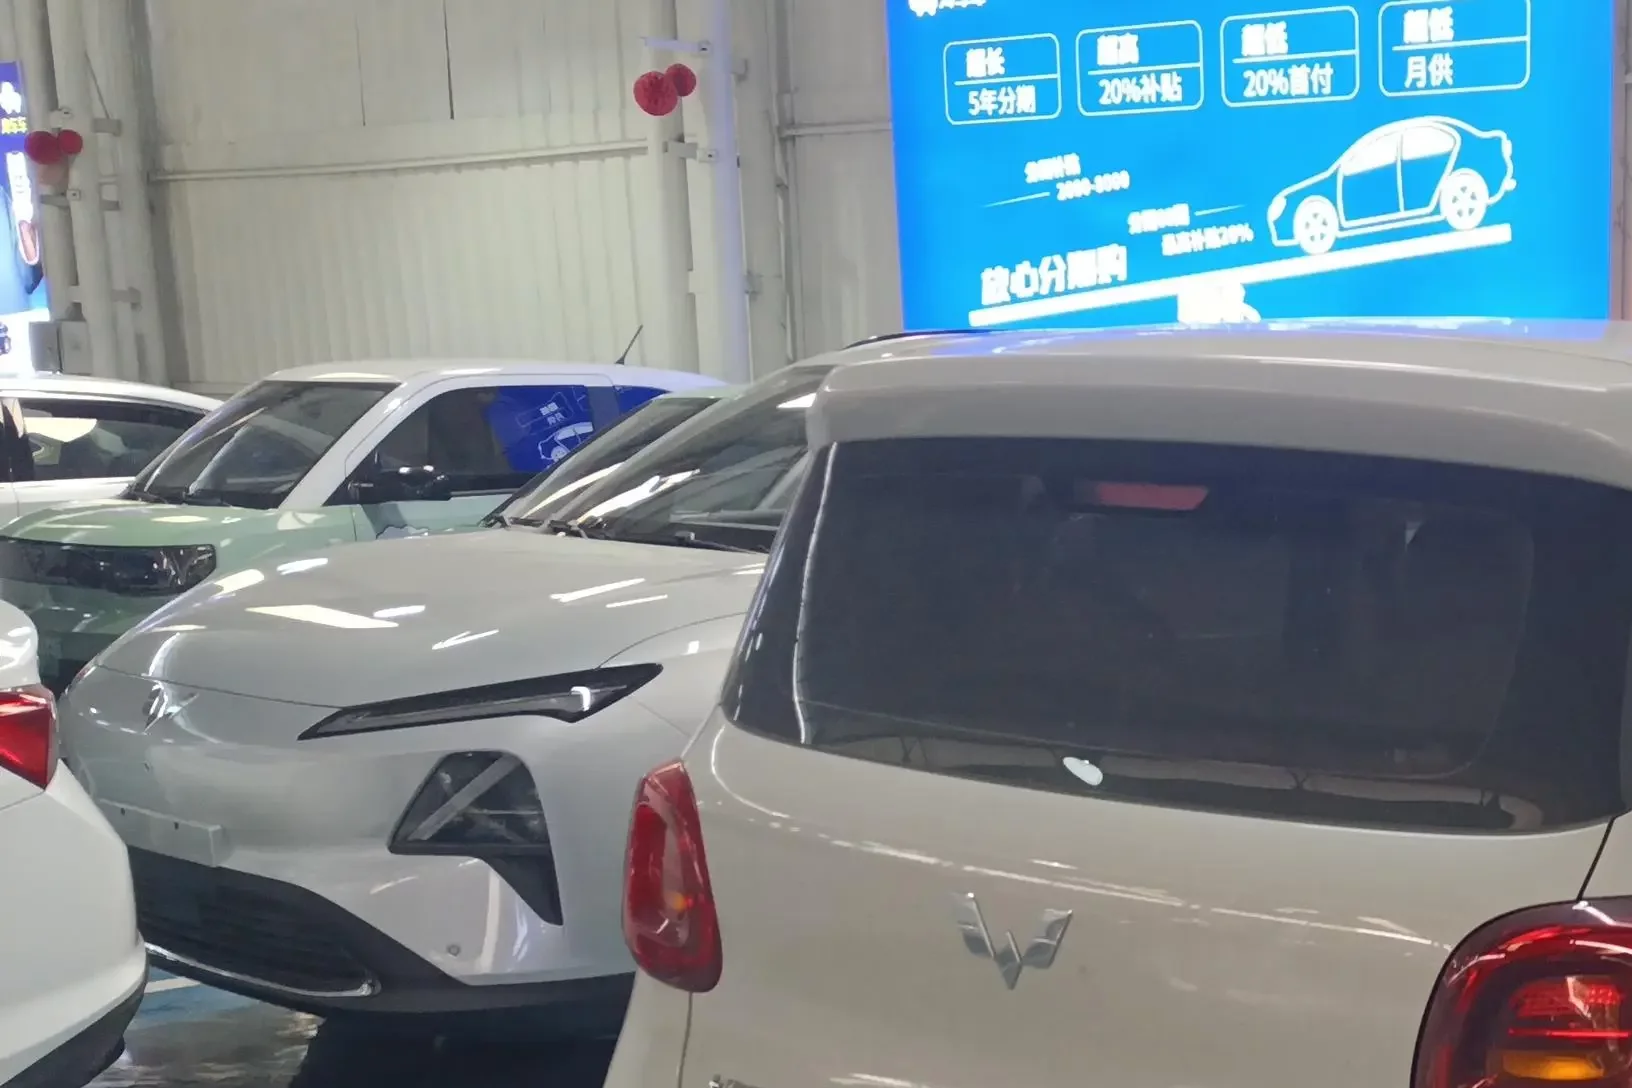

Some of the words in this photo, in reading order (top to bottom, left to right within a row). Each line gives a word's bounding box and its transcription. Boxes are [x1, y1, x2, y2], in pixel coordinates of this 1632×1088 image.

[1243, 62, 1334, 98] 20%首付
[1404, 53, 1454, 88] 月供
[968, 84, 1037, 116] 5年分期
[1099, 71, 1183, 105] 20%补贴
